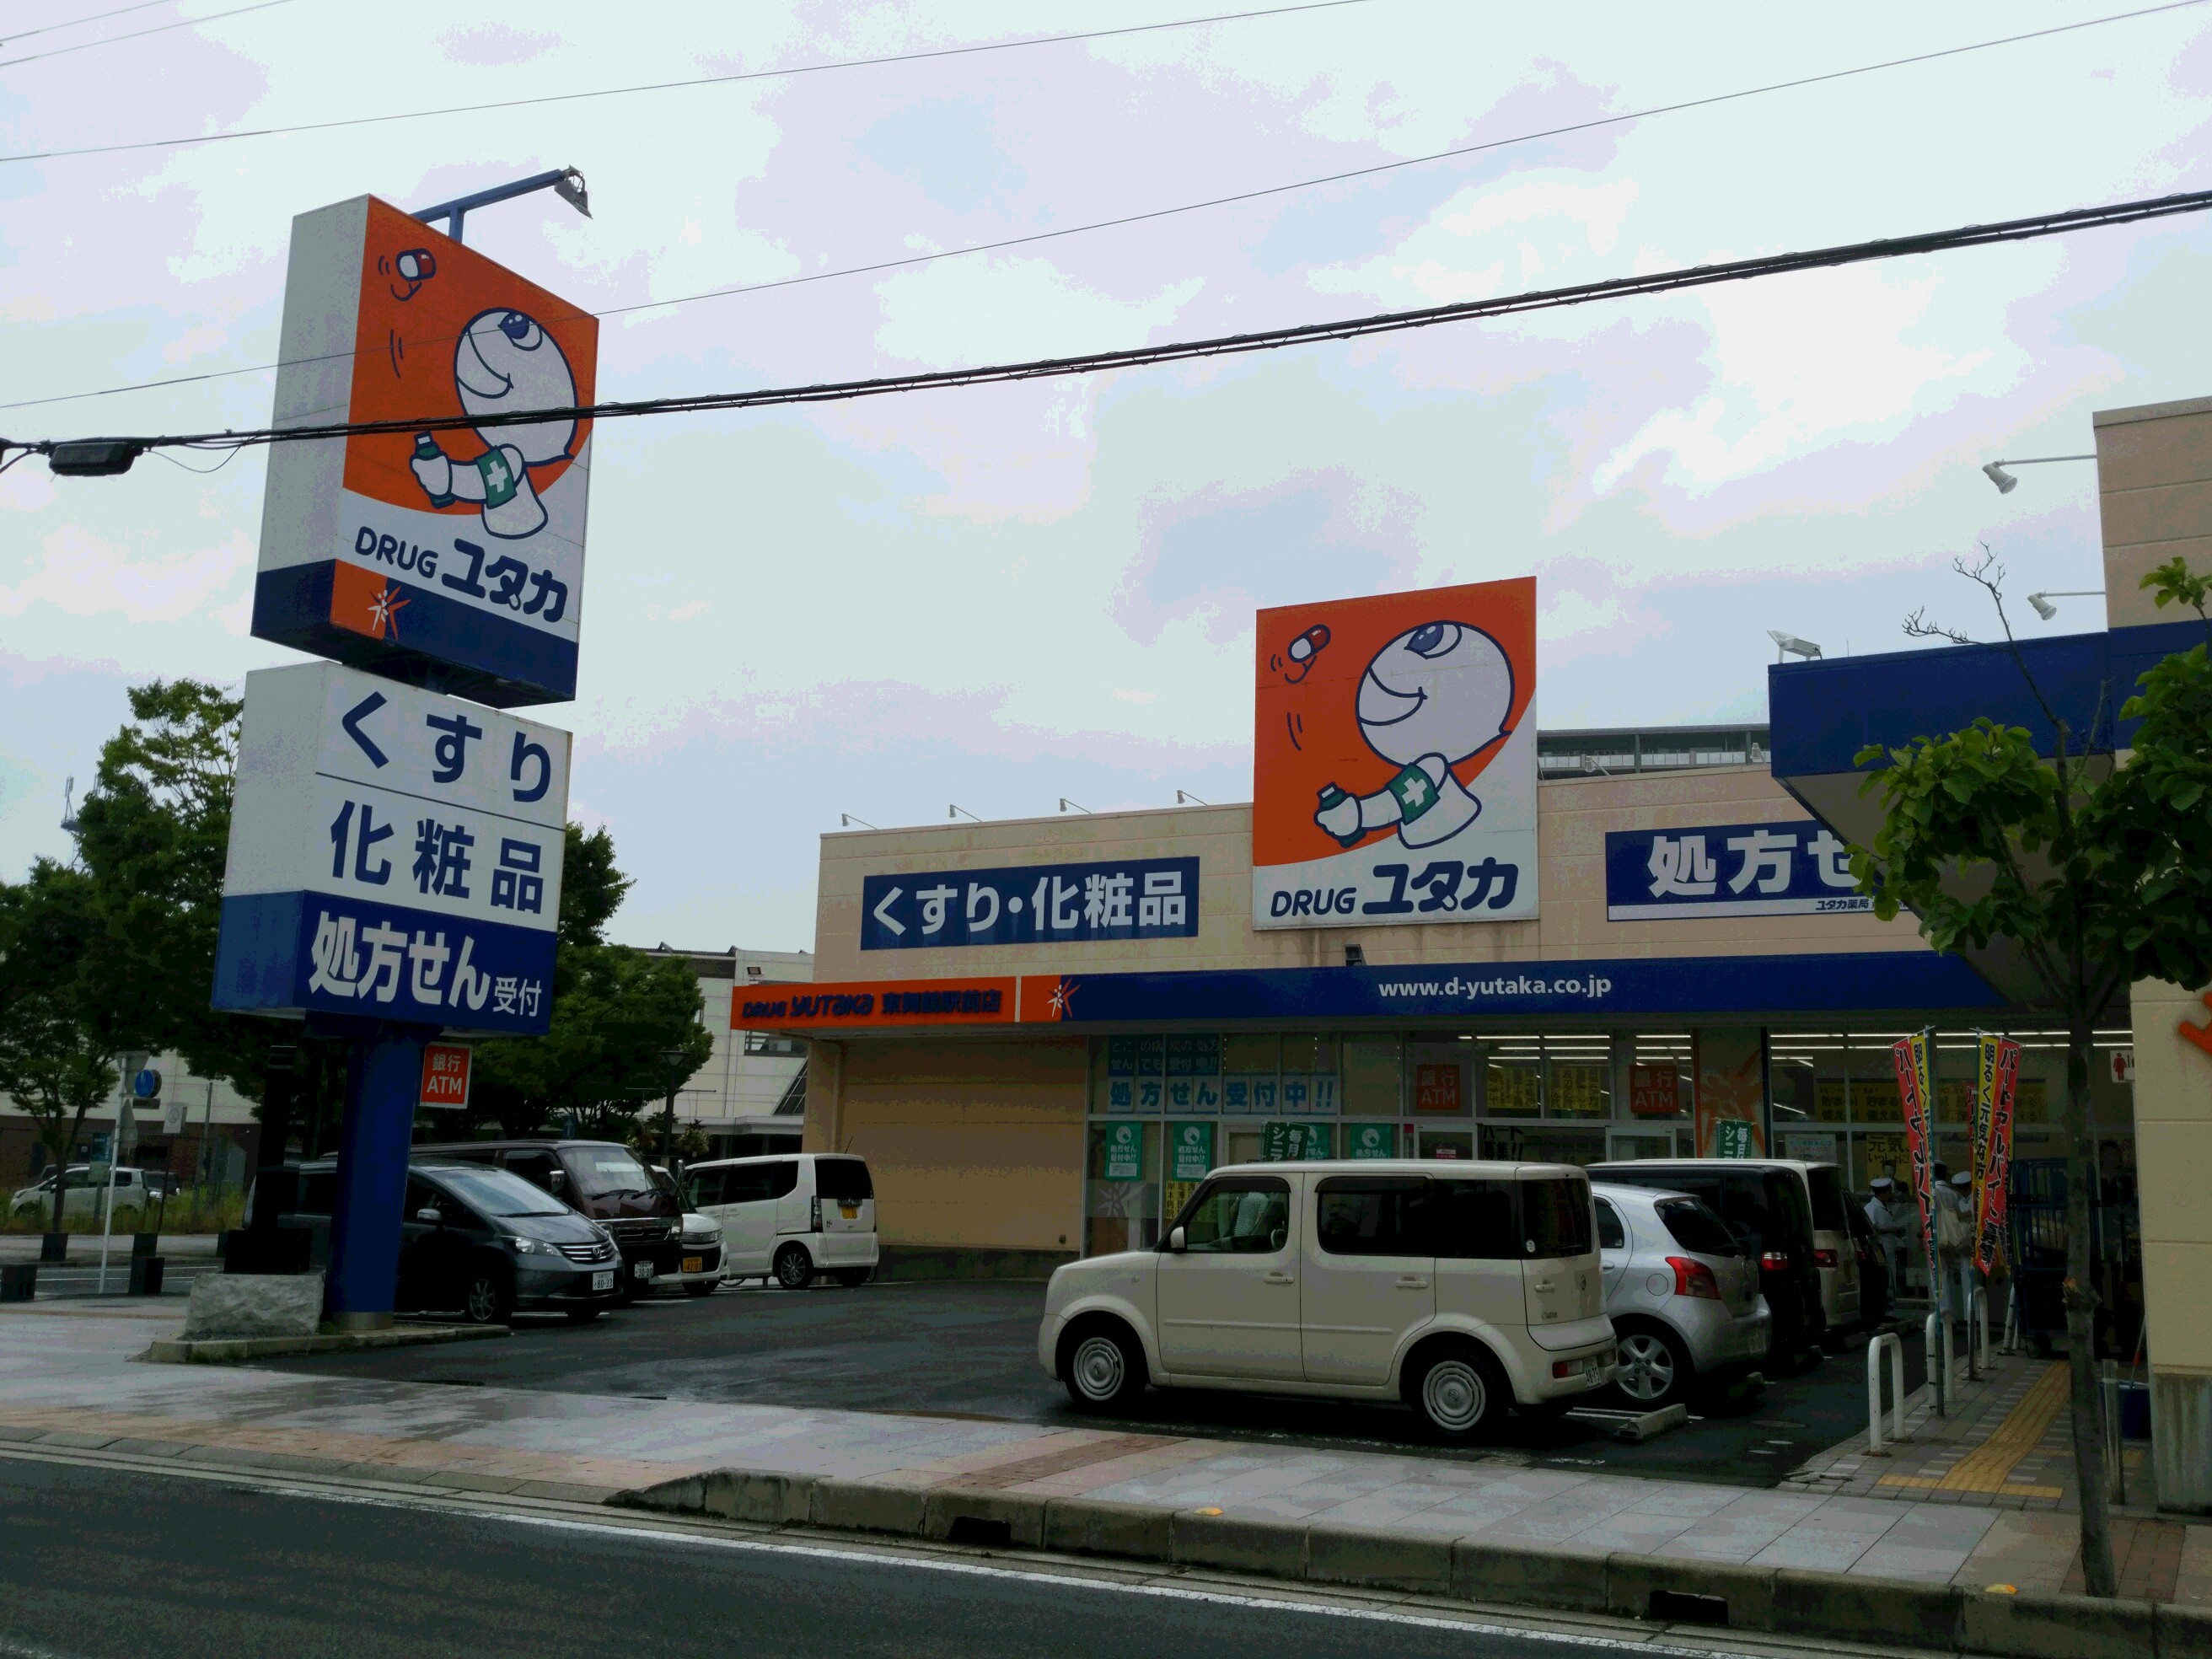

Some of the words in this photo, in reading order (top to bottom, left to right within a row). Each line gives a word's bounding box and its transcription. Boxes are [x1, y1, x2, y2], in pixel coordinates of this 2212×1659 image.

[355, 526, 438, 579] DRUG
[442, 539, 568, 623] ユタカ
[341, 691, 552, 803] くすり
[330, 800, 545, 915] 化粧品
[1270, 888, 1357, 918] DRUG
[1361, 856, 1518, 915] ユタカ
[872, 870, 1187, 937] くすり・化粧品
[1378, 975, 1611, 999] www.d-yutaka.co.jp
[743, 1001, 787, 1018] DRUG
[432, 1054, 461, 1072] 銀行
[426, 1076, 463, 1095] ATM
[1421, 1070, 1457, 1087] 銀行
[1634, 1071, 1673, 1088] 銀行
[1421, 1088, 1456, 1105] ATM
[1635, 1091, 1673, 1108] ATM
